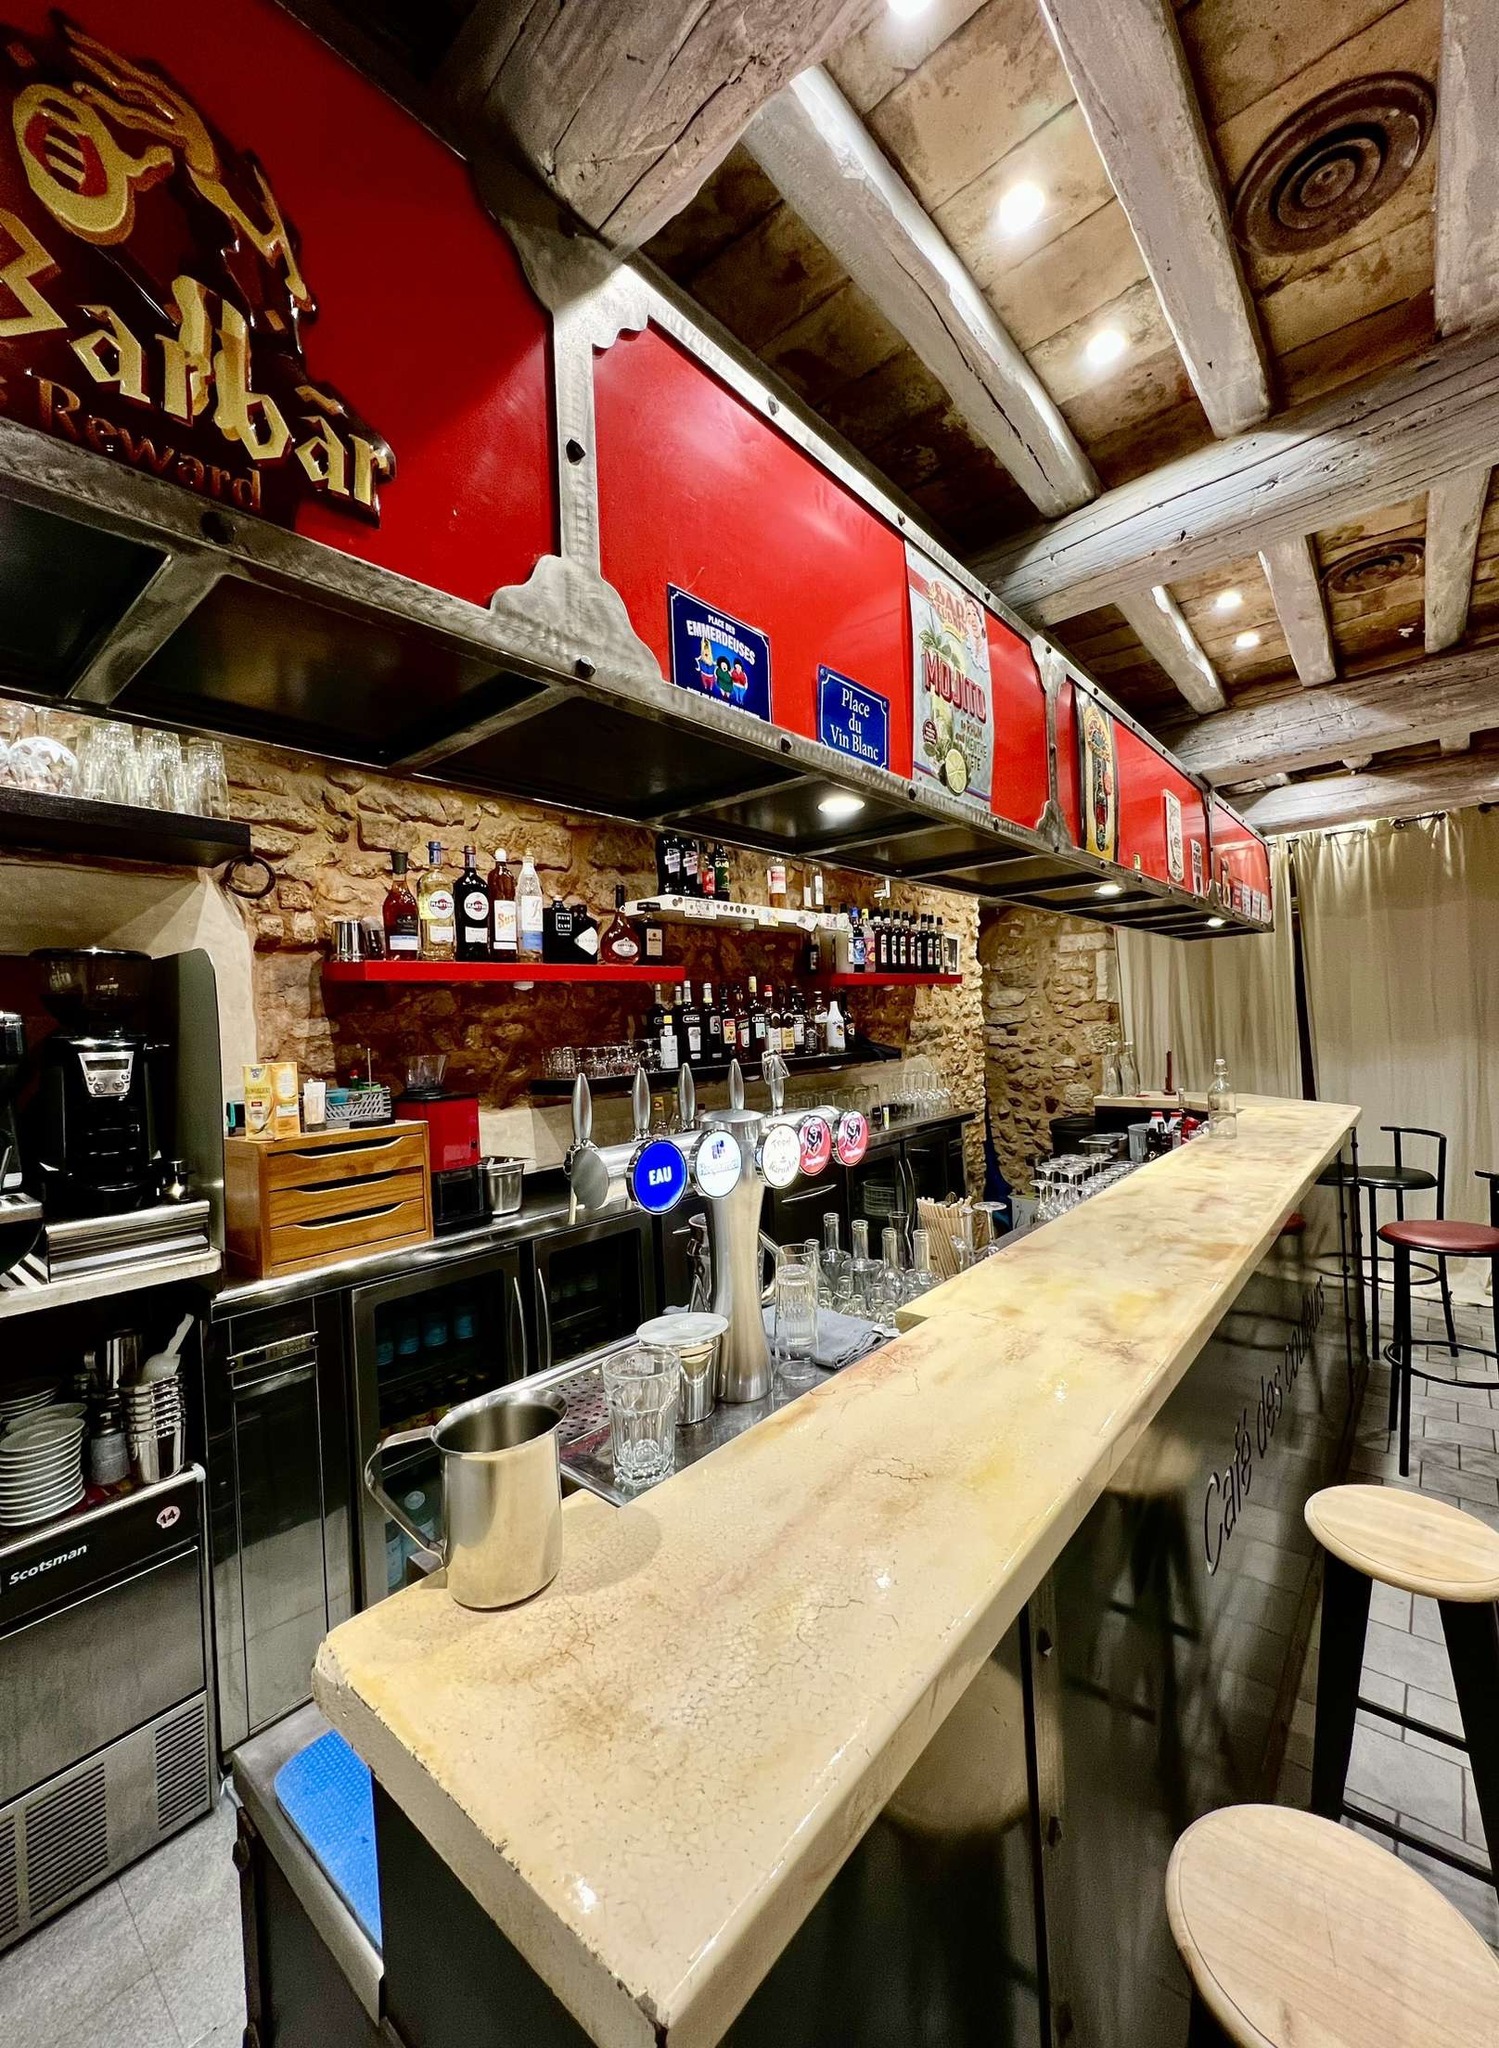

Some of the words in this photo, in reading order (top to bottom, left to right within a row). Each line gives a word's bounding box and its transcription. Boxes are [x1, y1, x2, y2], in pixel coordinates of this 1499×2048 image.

[35, 374, 262, 510] Reward
[686, 619, 756, 666] EMMERDEUSES
[708, 614, 725, 630] PLACE
[725, 622, 736, 636] DES
[841, 687, 870, 718] Place
[922, 650, 987, 724] MOJITO
[830, 723, 849, 749] Vin
[852, 733, 879, 761] Blanc
[848, 712, 862, 735] du
[648, 1166, 673, 1187] EAU
[1204, 1407, 1252, 1576] Café
[1257, 1365, 1283, 1459] des
[160, 1509, 177, 1525] 14
[9, 1544, 89, 1586] Scotsman
